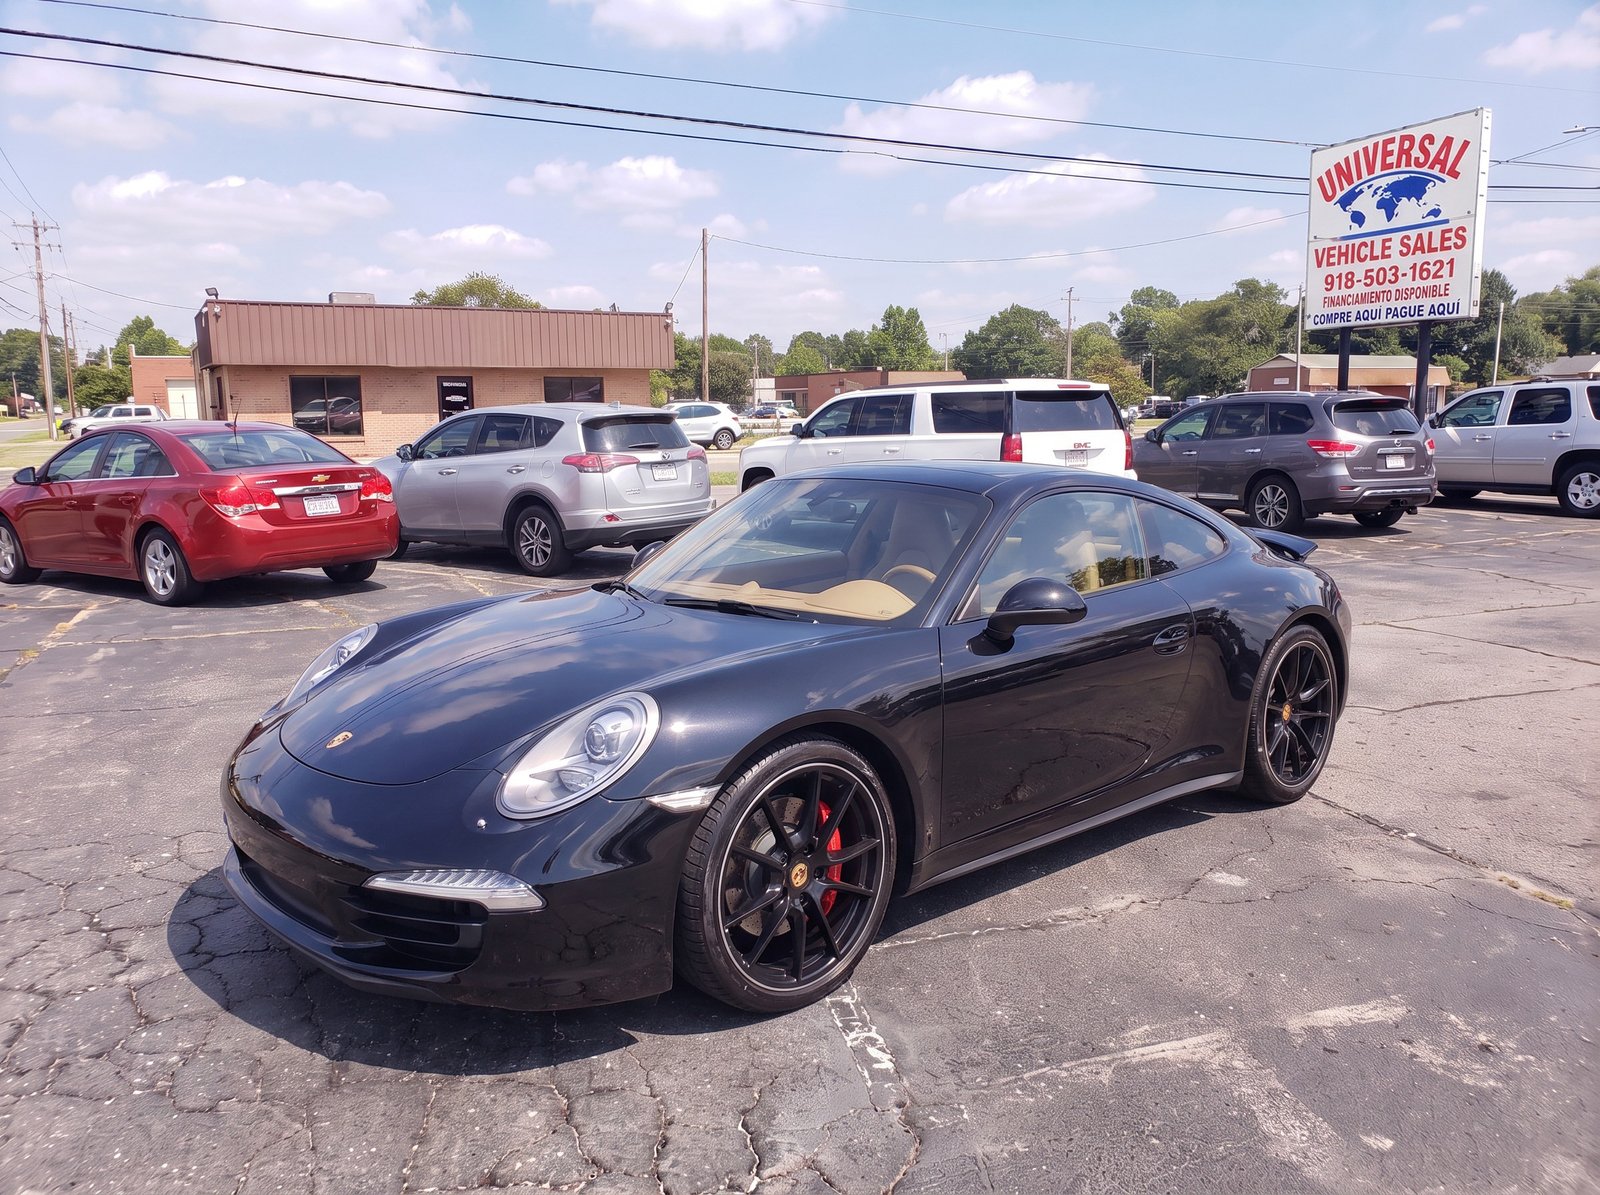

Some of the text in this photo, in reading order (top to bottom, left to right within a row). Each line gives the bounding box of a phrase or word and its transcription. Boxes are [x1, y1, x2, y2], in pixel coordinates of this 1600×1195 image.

[1317, 133, 1471, 203] UNIVERSAL
[1314, 225, 1468, 268] VEHICLE SALES
[1324, 257, 1455, 292] 918-503-1621
[1313, 299, 1460, 325] COMPRE AQUÍ PAGUE AQUÍ
[1322, 283, 1450, 308] FINANCIAMIENTO DISPONIBLE
